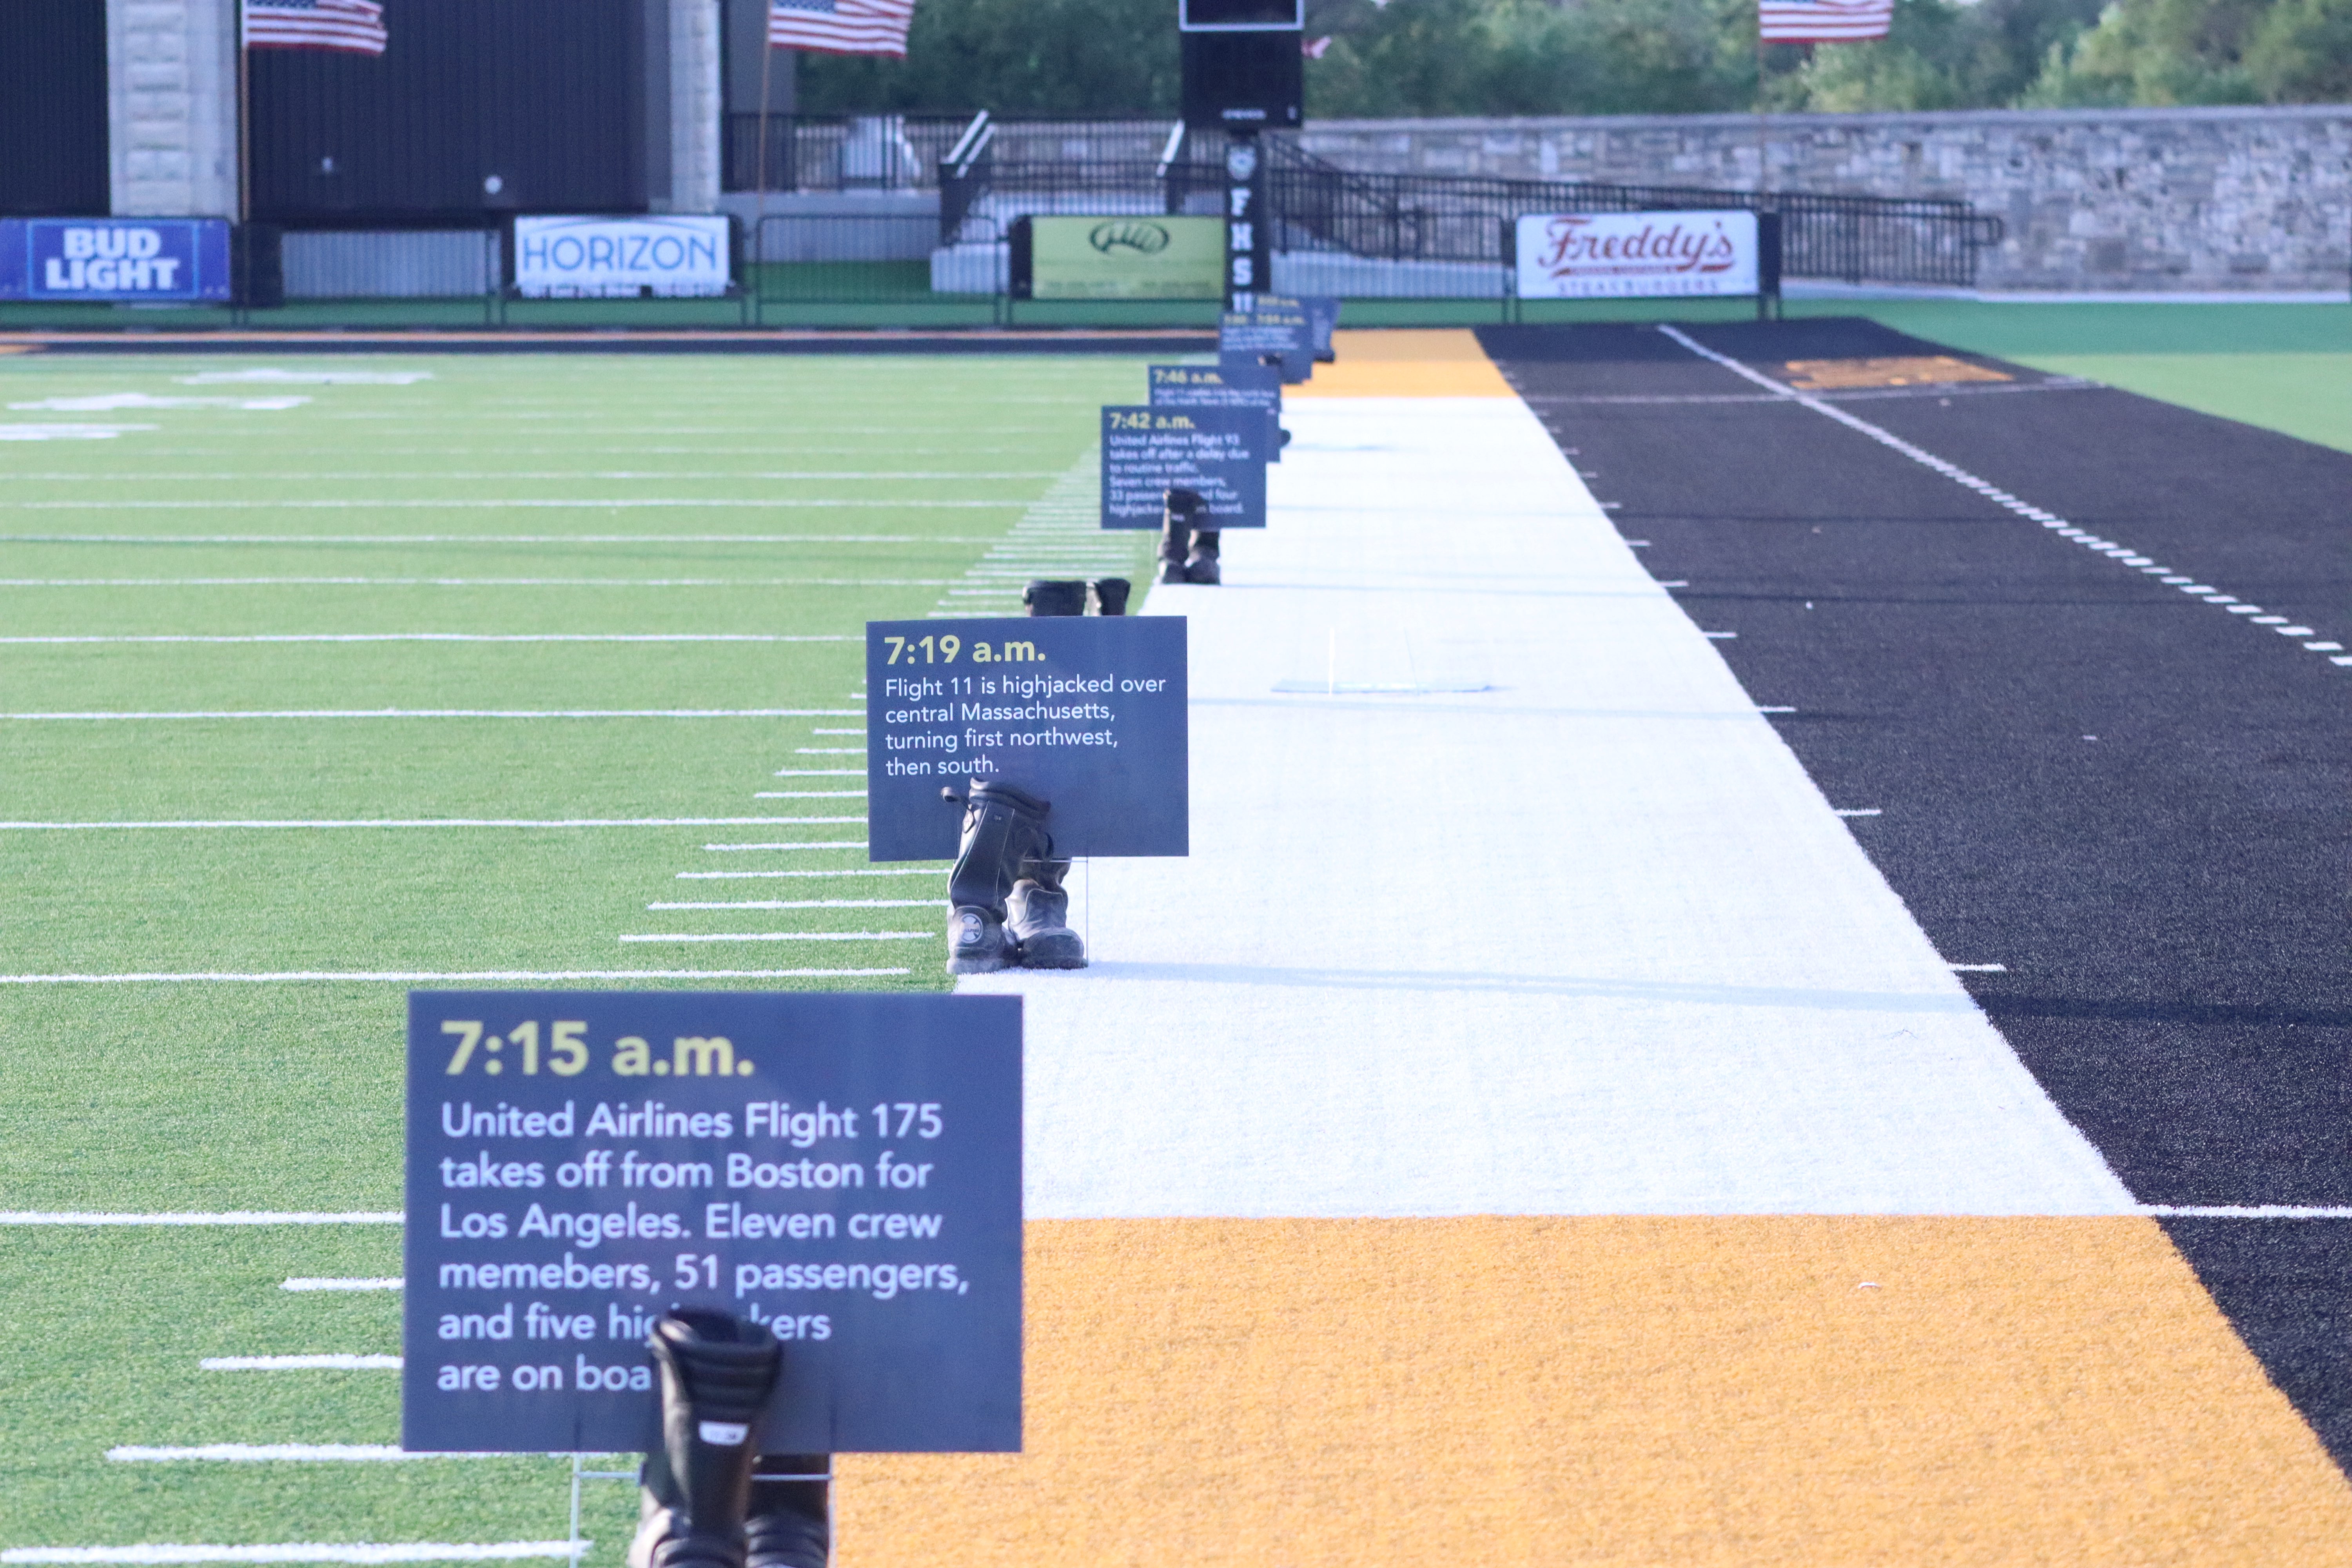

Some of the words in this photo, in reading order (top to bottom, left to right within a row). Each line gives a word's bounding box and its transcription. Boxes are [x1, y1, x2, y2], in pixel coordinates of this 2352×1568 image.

[63, 227, 161, 260] BUD
[523, 236, 717, 271] HORIZON
[1537, 218, 1735, 270] Freddy's
[45, 258, 180, 290] LIGHT
[1111, 412, 1150, 429] 7:42
[1156, 416, 1195, 429] a.m.
[884, 635, 960, 664] 7:19
[973, 641, 1045, 662] a.m.
[886, 677, 942, 702] Flight
[951, 677, 971, 694] 11
[982, 677, 996, 694] is
[1003, 674, 1113, 699] highjacked
[1121, 679, 1166, 692] over
[886, 702, 953, 723] central
[962, 701, 1114, 721] Massachusetts,
[886, 730, 957, 753] turning
[964, 727, 1003, 746] first
[1010, 726, 1118, 748] northwest,
[886, 757, 930, 776] then
[938, 753, 999, 775] south.
[441, 1021, 588, 1076] 7:15
[612, 1037, 754, 1076] a.m.
[443, 1100, 574, 1137] United
[586, 1100, 733, 1138] Airlines
[746, 1101, 857, 1148] Flight
[873, 1103, 942, 1138] 175
[440, 1151, 545, 1188] takes
[556, 1149, 612, 1187] off
[620, 1149, 713, 1189] from
[728, 1153, 863, 1189] Boston
[876, 1151, 933, 1189] for
[441, 1203, 508, 1238] Los
[518, 1200, 691, 1248] Angeles.
[706, 1202, 835, 1238] Eleven
[848, 1214, 942, 1239] crew
[440, 1251, 660, 1296] memebers,
[675, 1254, 717, 1289] 51
[736, 1264, 968, 1299] passengers,
[438, 1302, 513, 1340] and
[524, 1302, 596, 1339] five
[438, 1365, 501, 1390] are
[512, 1365, 563, 1390] on
[576, 1353, 651, 1391] boa
